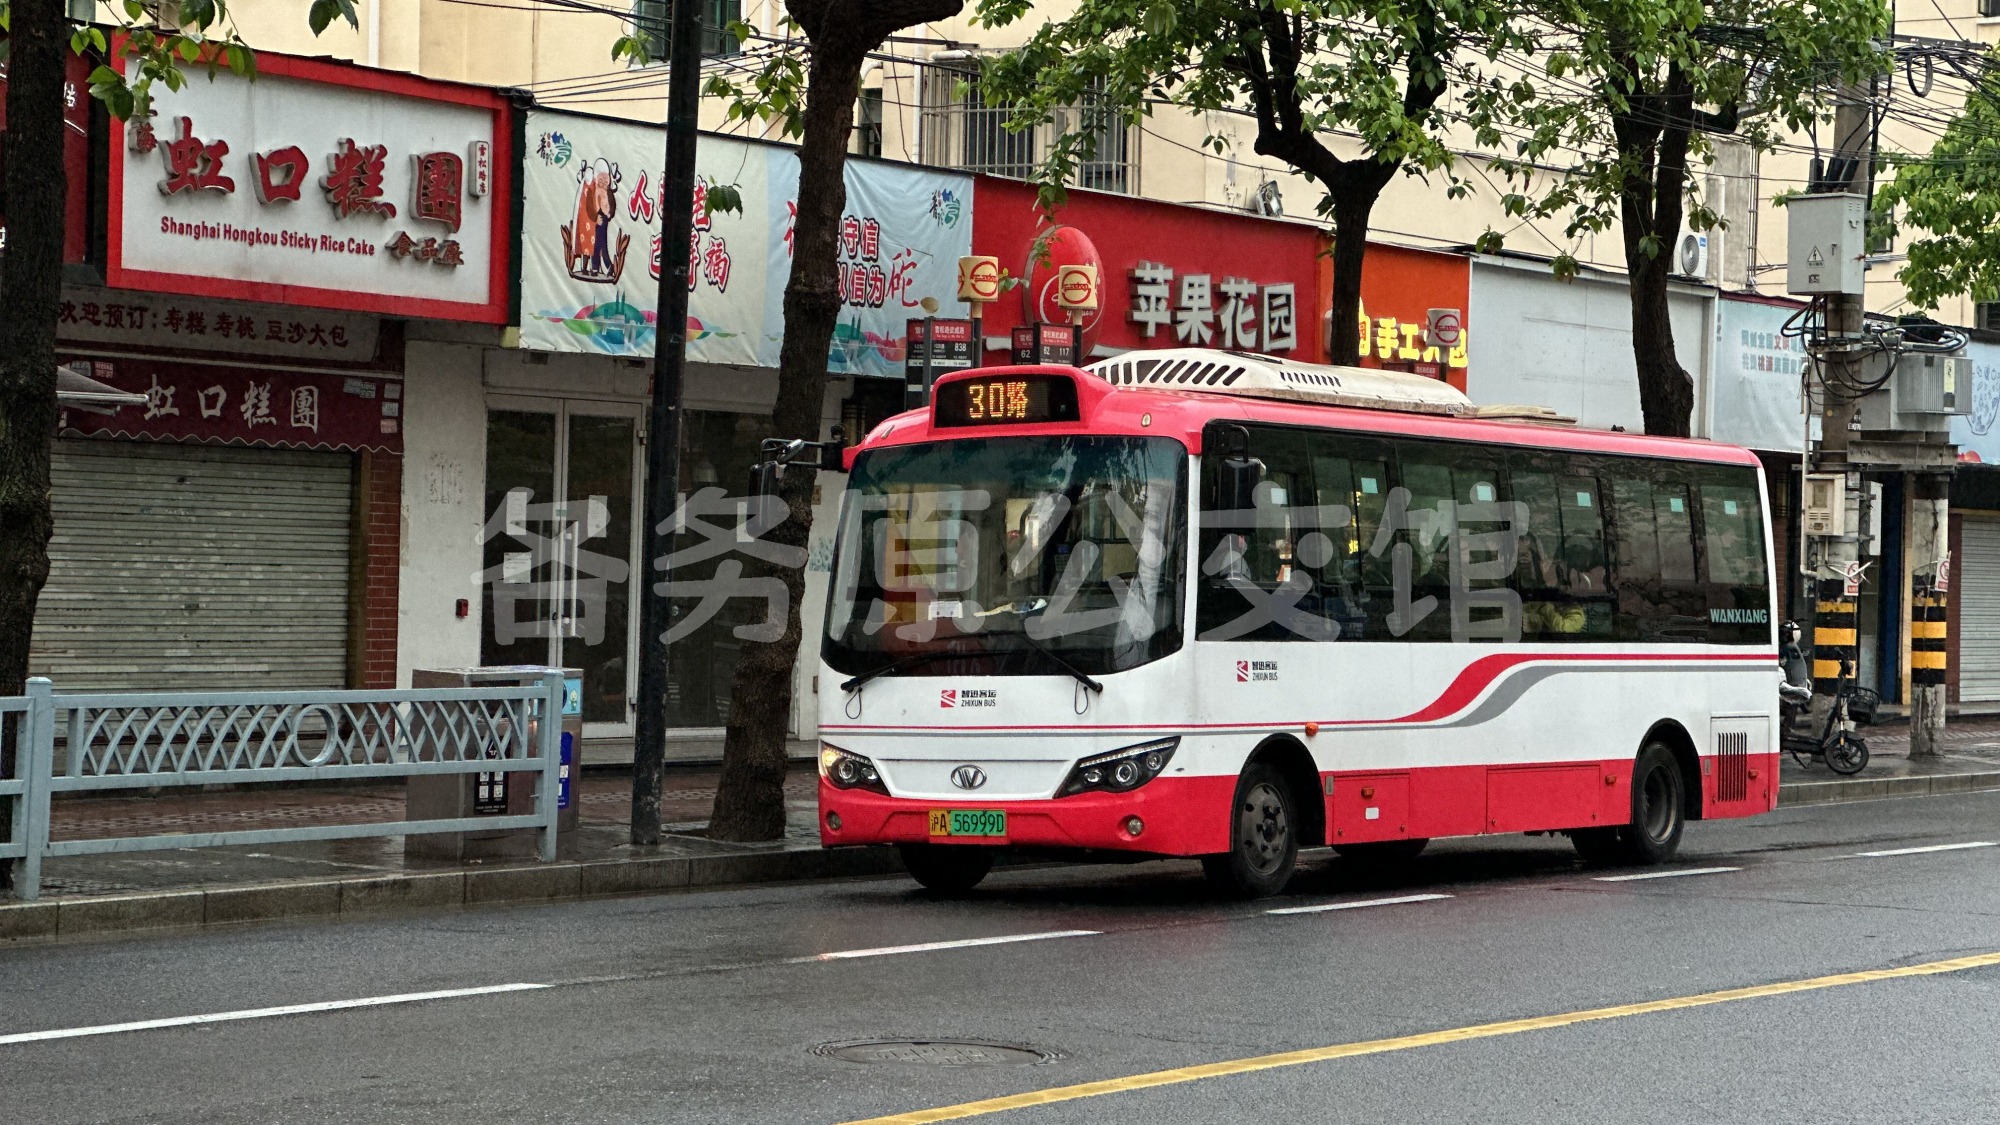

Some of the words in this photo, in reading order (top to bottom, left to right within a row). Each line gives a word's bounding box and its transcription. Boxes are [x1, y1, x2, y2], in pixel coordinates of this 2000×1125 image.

[160, 116, 463, 233] 虹口糕團
[161, 216, 221, 240] Shanghai
[223, 224, 278, 247] Hongkou
[280, 230, 318, 253] Sticky
[320, 234, 345, 252] Rice
[347, 238, 375, 256] Cake
[1129, 261, 1298, 352] 苹果花园
[954, 342, 967, 352] 838
[1020, 349, 1031, 358] 62
[1059, 347, 1070, 357] 117
[143, 373, 320, 434] 虹口糕團
[969, 381, 1028, 419] 30路
[1710, 608, 1768, 624] WANXIANG
[1269, 671, 1278, 681] BUS
[961, 699, 983, 707] ZHIXUN
[984, 699, 996, 707] BUS
